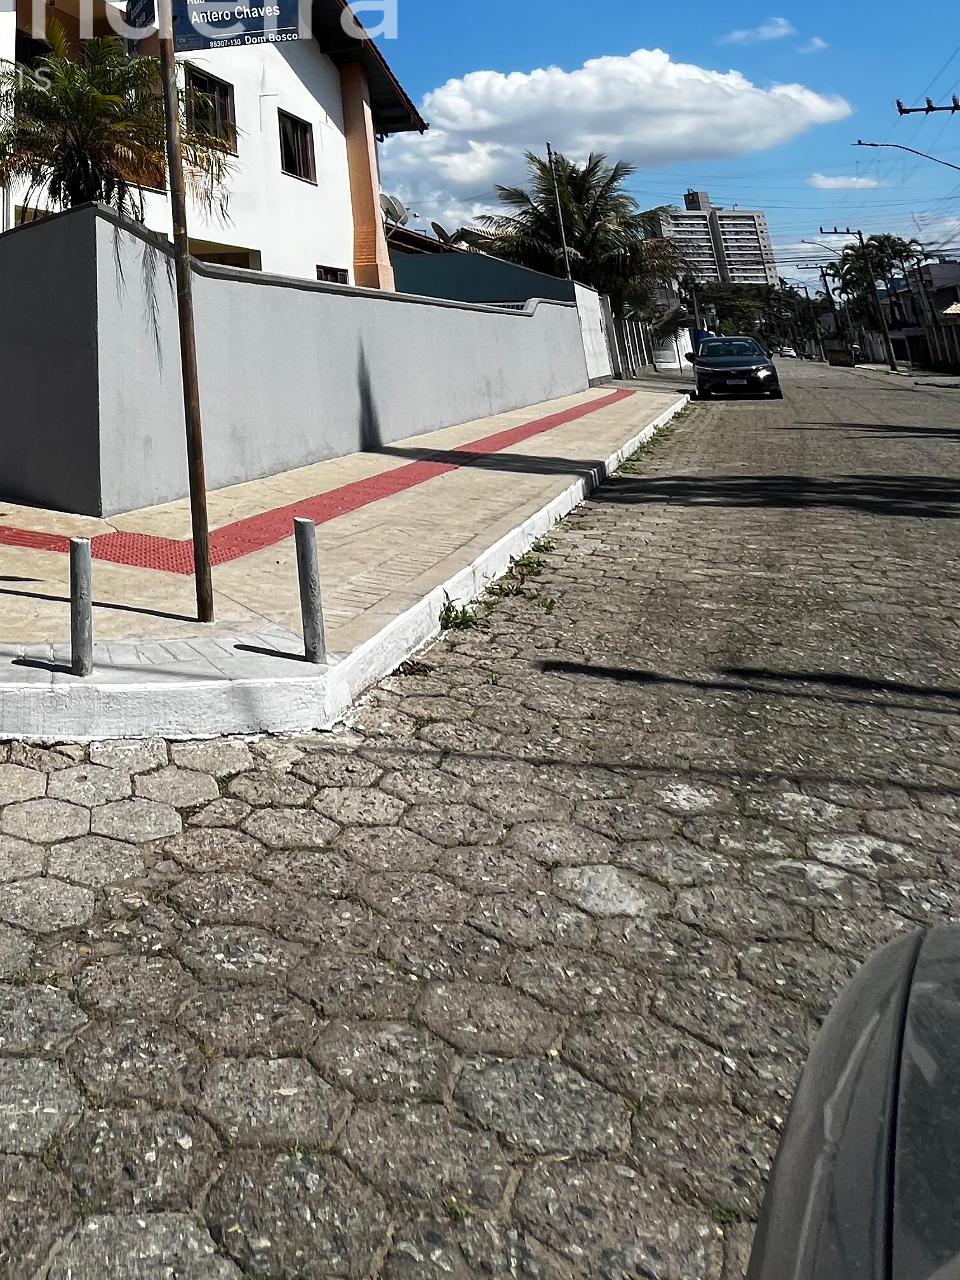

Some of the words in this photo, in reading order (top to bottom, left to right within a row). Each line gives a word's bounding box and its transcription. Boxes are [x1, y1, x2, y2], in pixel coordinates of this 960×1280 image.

[191, 10, 231, 25] Antero
[234, 5, 280, 20] Chaves
[244, 34, 266, 45] Dom
[268, 32, 298, 42] Bosco
